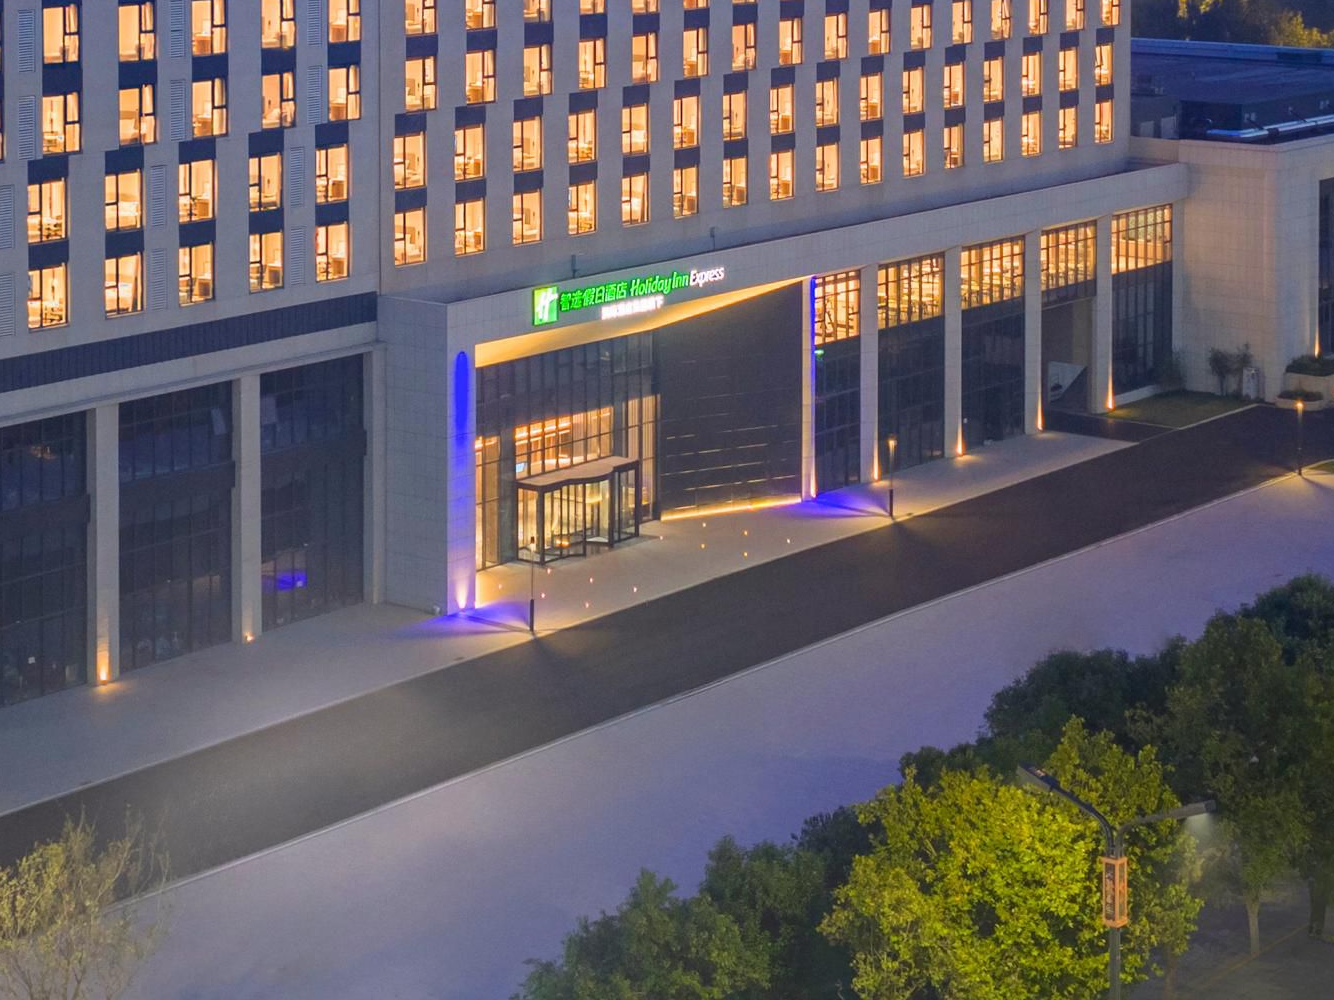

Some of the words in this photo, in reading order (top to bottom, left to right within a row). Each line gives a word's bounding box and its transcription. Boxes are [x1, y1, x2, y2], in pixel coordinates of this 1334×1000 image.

[560, 282, 628, 312] 智选假日酒店
[630, 275, 672, 297] Holiday
[672, 271, 689, 288] Inn
[689, 267, 725, 288] Express
